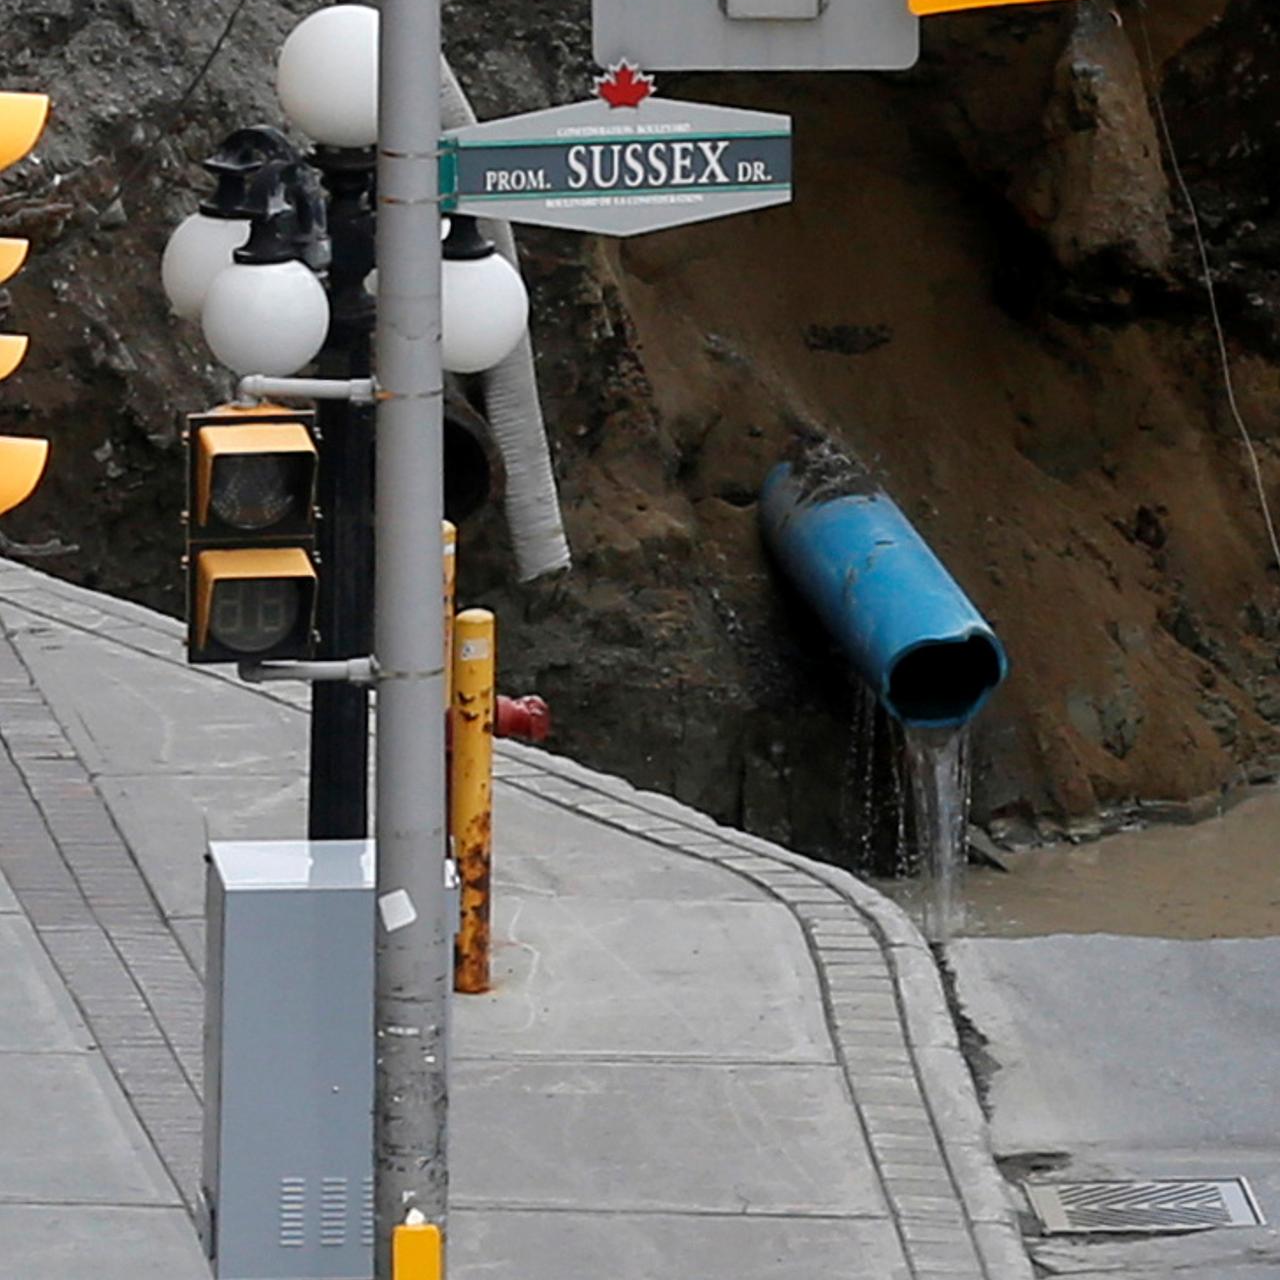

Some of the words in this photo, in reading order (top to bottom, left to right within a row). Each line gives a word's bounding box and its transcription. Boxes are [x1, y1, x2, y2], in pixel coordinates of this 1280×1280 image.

[485, 169, 552, 192] PROM.
[568, 140, 730, 189] SUSSEX
[737, 160, 773, 183] DR.
